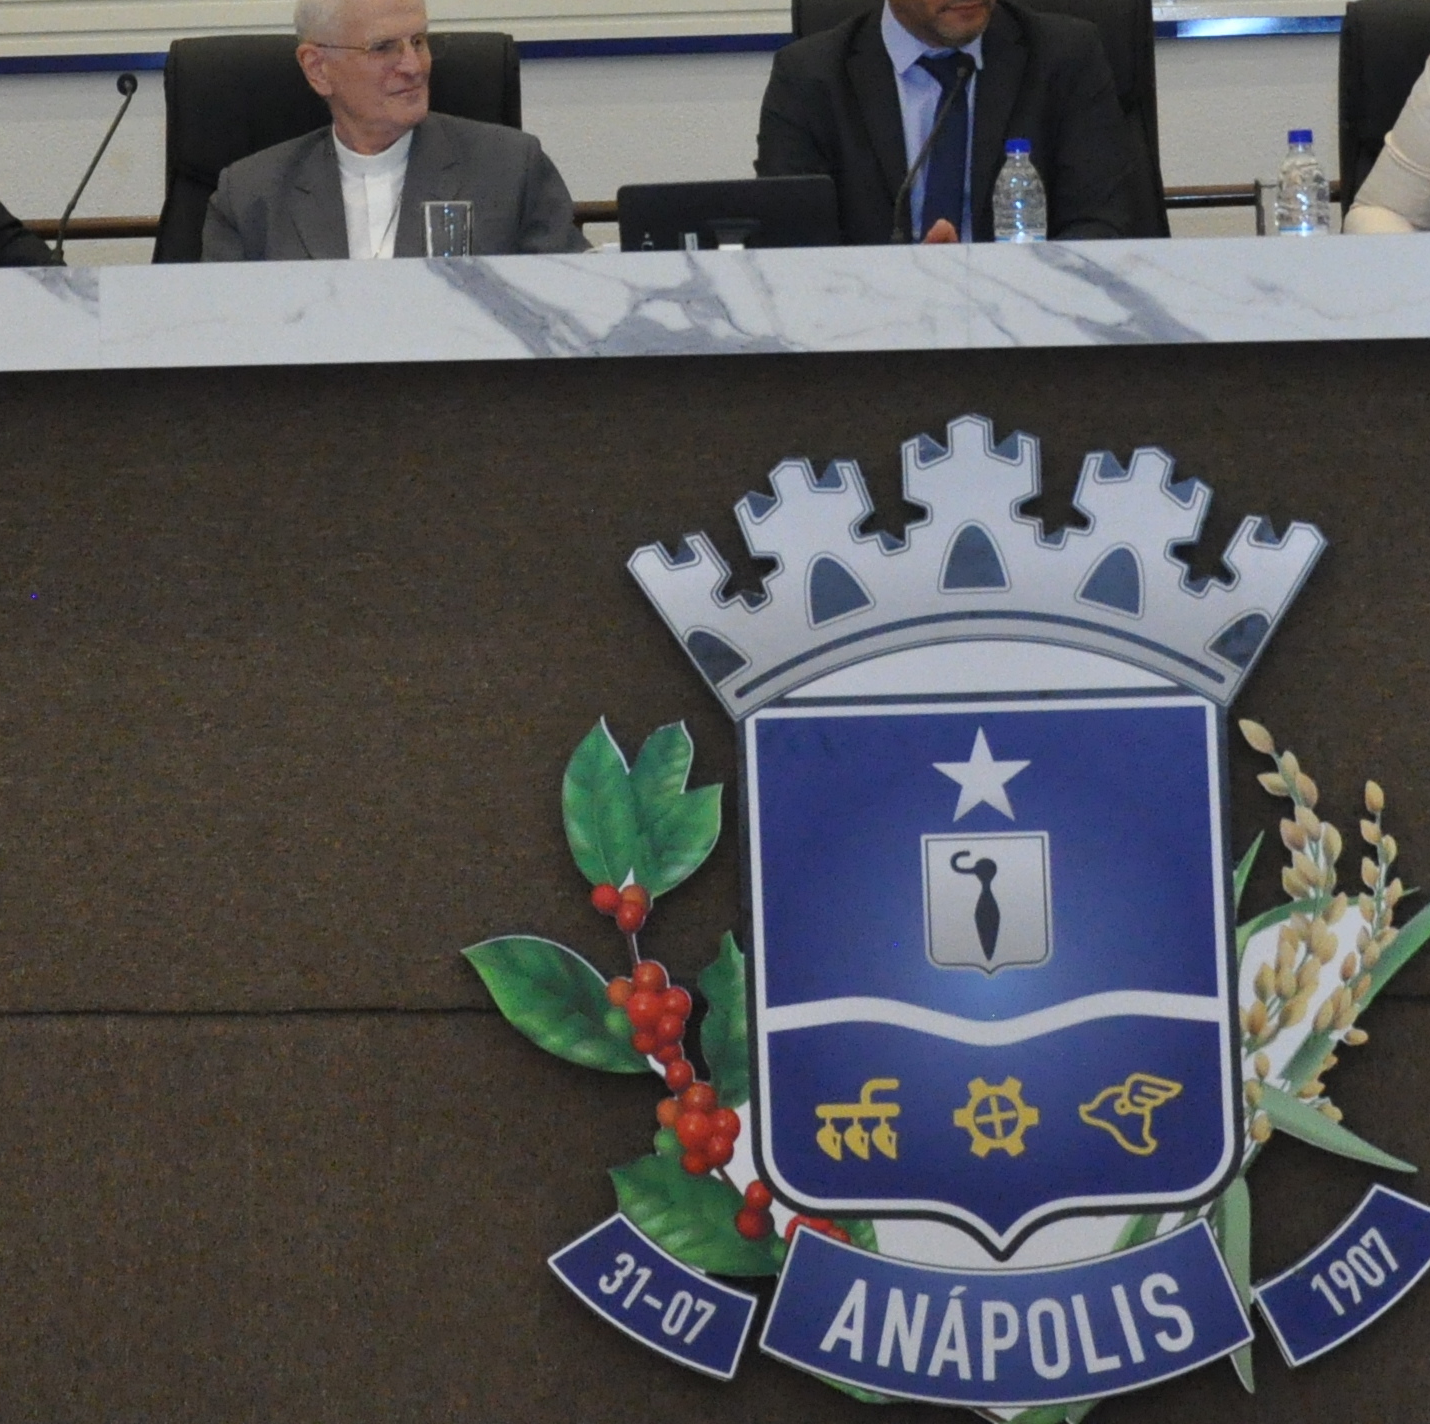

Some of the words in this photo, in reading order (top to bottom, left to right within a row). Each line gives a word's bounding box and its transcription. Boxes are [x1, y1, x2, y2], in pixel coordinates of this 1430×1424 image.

[598, 1253, 716, 1344] 31-07
[1310, 1228, 1400, 1316] 1907
[819, 1273, 1194, 1380] ANÁPOLIS
